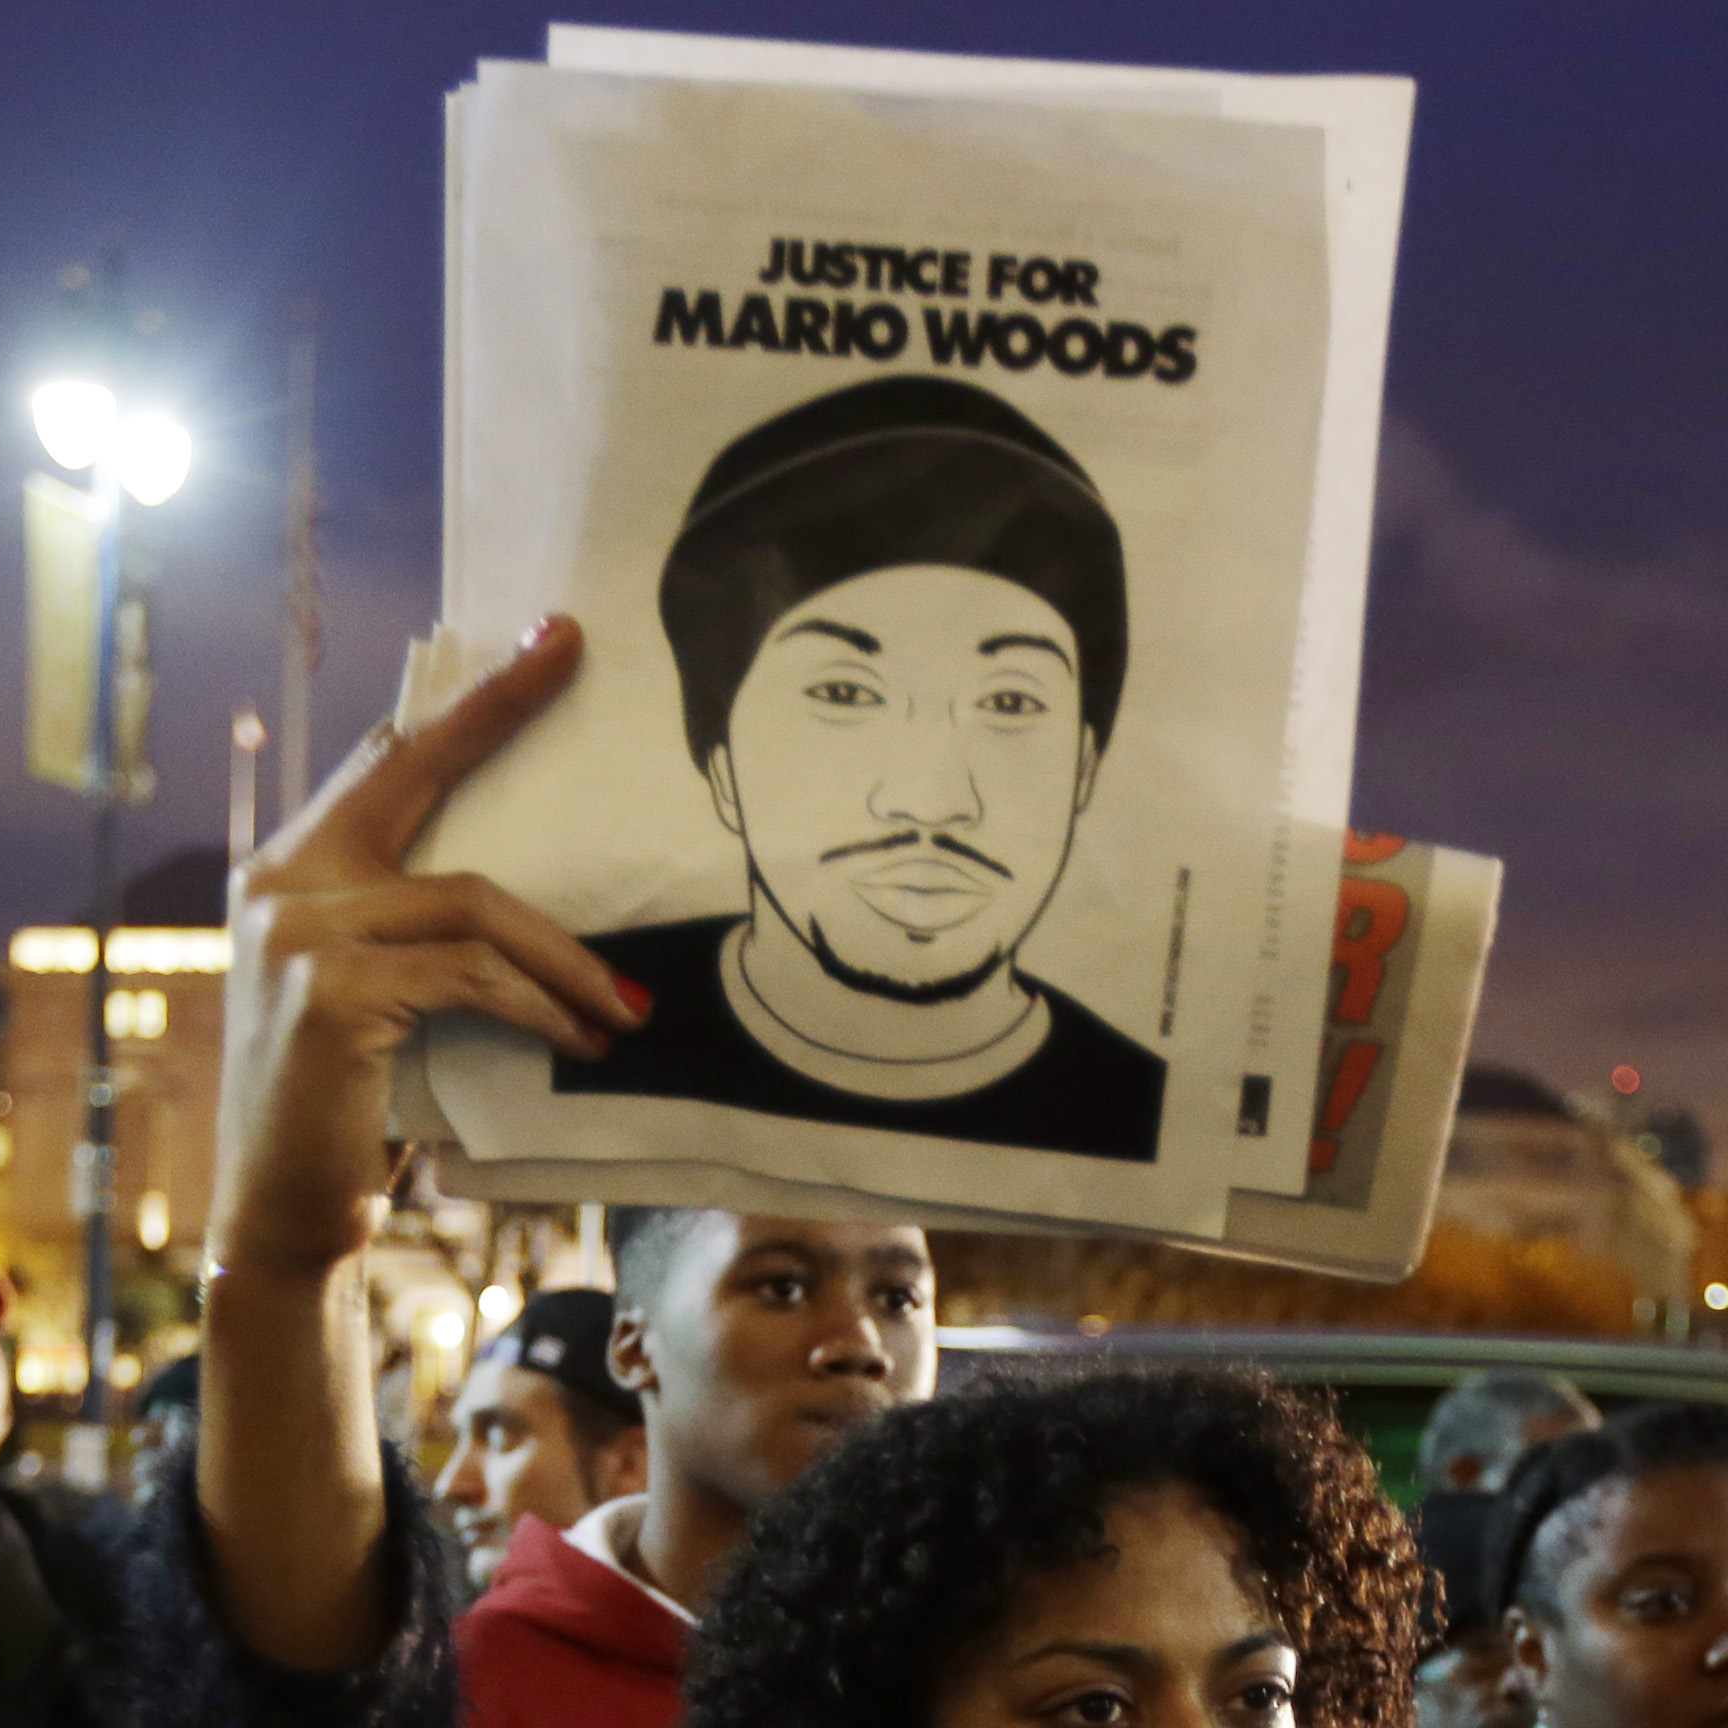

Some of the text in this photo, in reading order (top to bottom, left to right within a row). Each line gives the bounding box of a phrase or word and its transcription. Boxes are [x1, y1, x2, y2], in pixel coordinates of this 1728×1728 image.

[759, 238, 1100, 305] JUSTICE FOR
[654, 288, 1197, 384] MARIO WOODS
